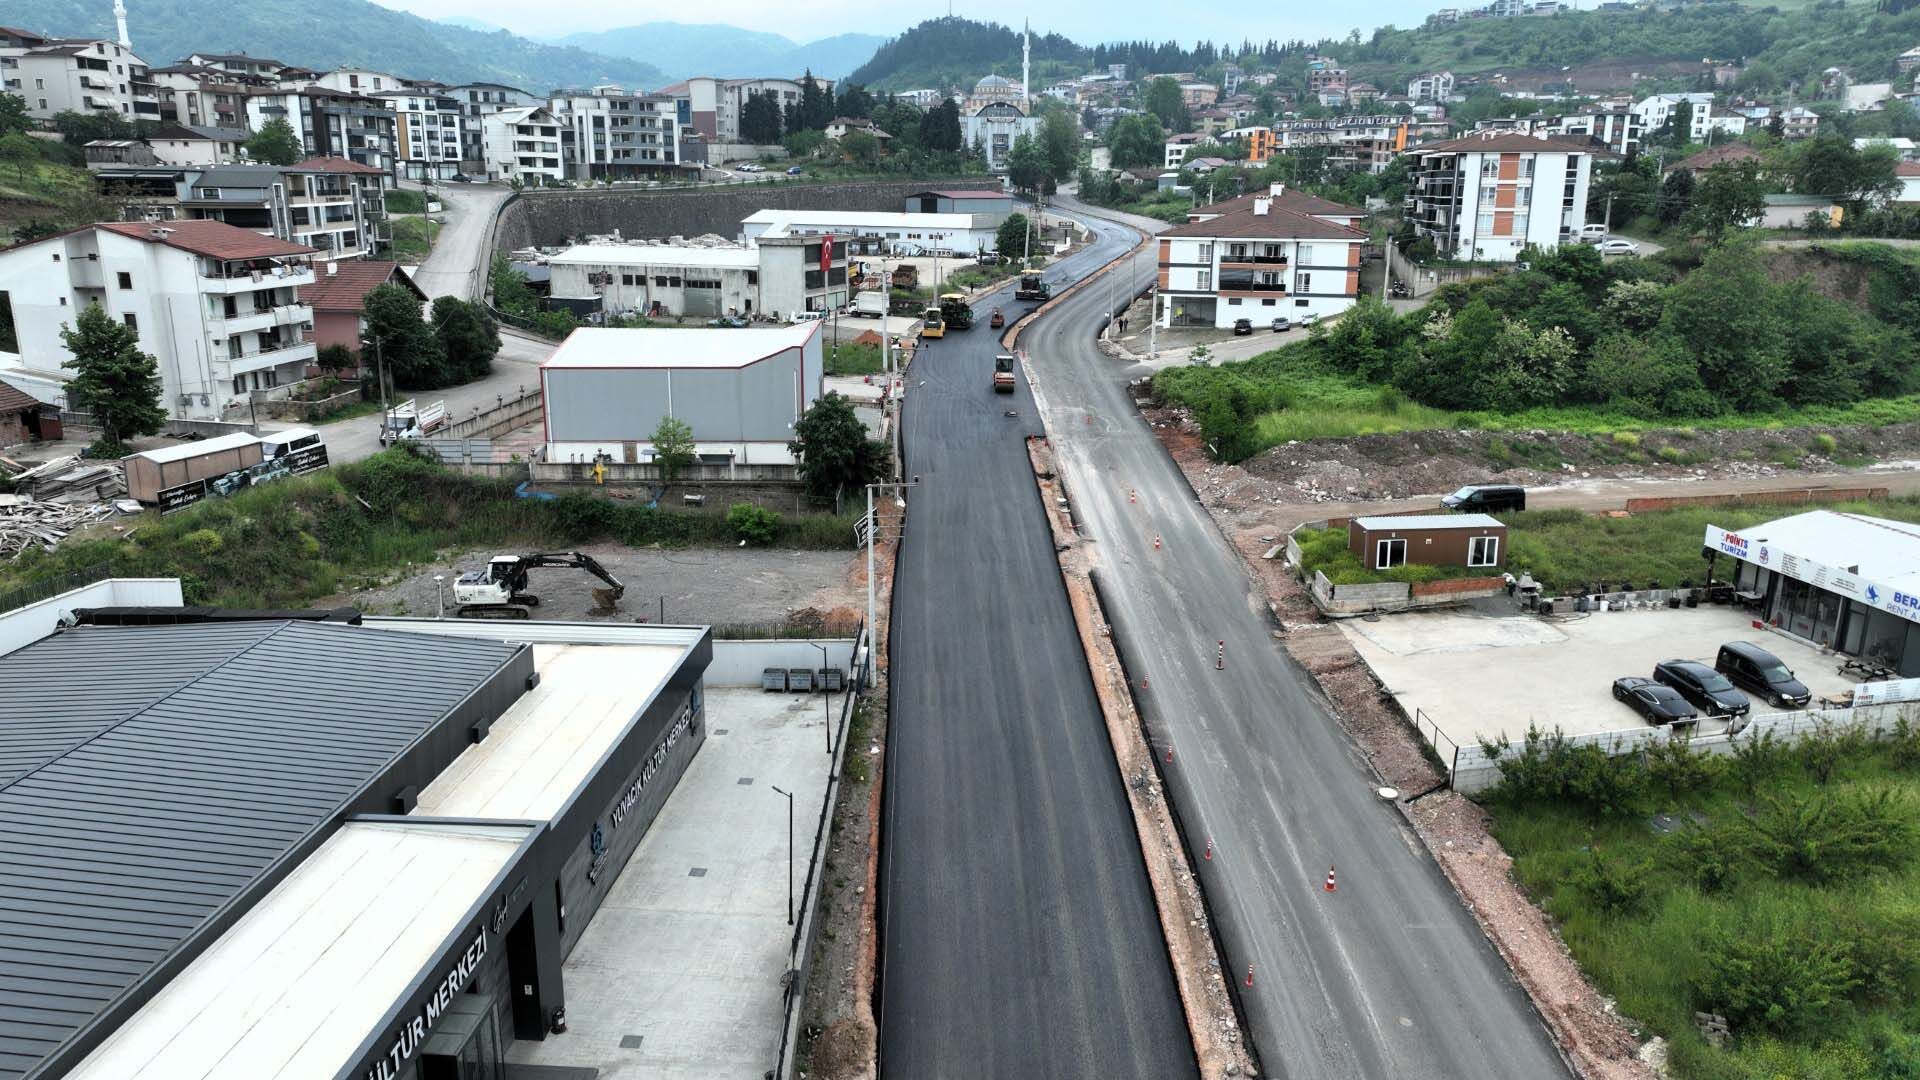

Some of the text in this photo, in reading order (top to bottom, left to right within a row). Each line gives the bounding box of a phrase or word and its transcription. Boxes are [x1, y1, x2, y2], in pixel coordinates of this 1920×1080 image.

[1720, 542, 1748, 559] TURİZM
[1886, 603, 1909, 617] RENT
[612, 780, 643, 828] YUVACIK
[643, 744, 667, 787] KÜLTÜR
[426, 925, 488, 1029] MERKEZİ
